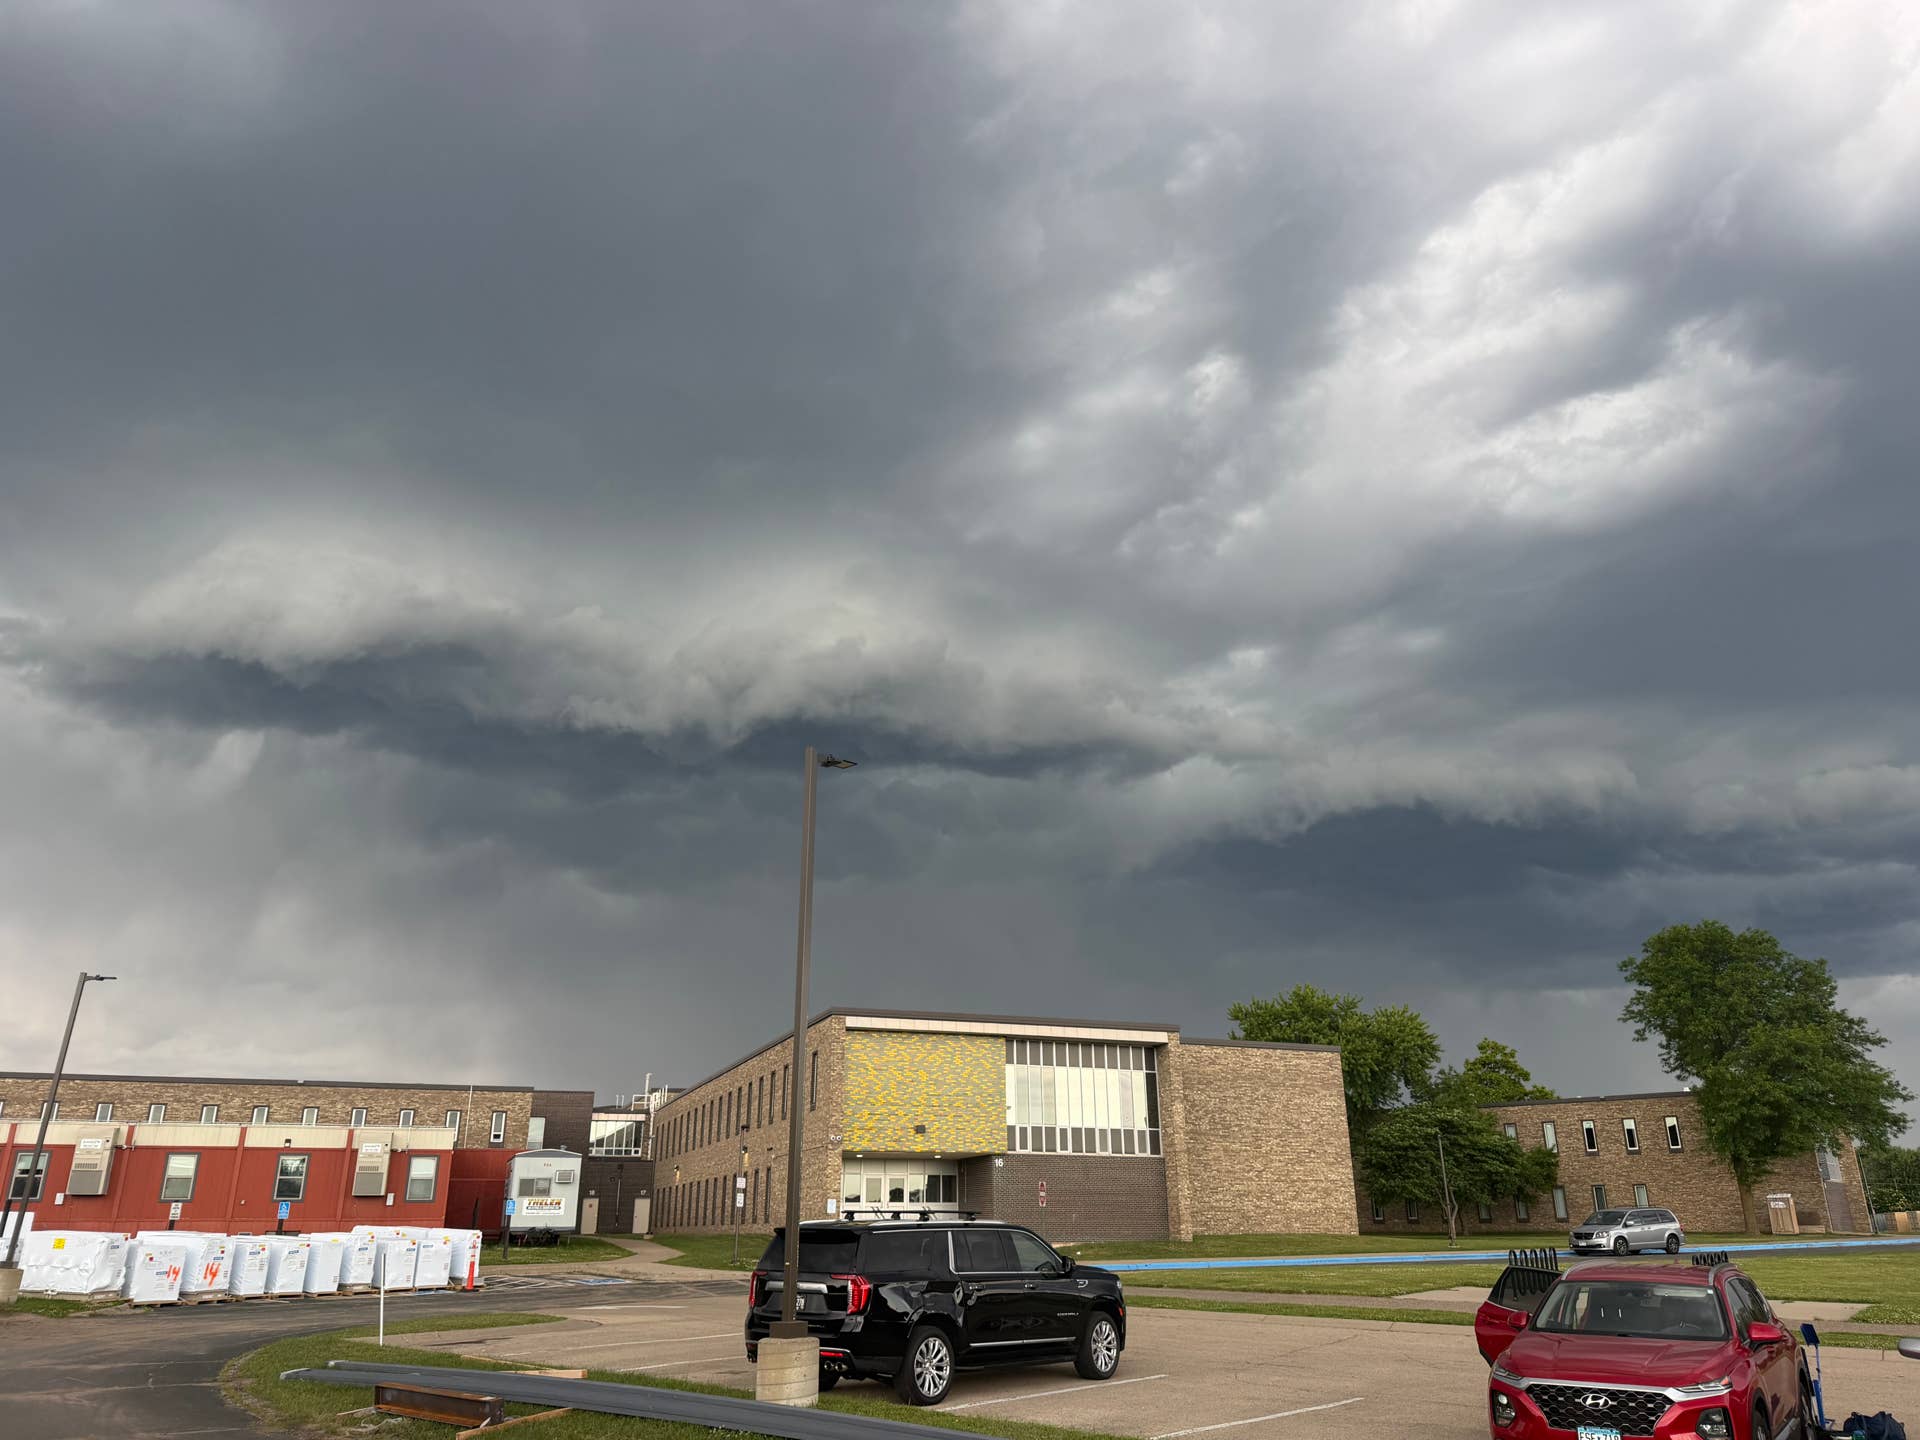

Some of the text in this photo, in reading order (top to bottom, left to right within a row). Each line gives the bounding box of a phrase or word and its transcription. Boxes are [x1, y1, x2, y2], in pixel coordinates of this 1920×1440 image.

[994, 1158, 1004, 1167] 16
[166, 1264, 181, 1283] 14
[203, 1262, 221, 1288] 14
